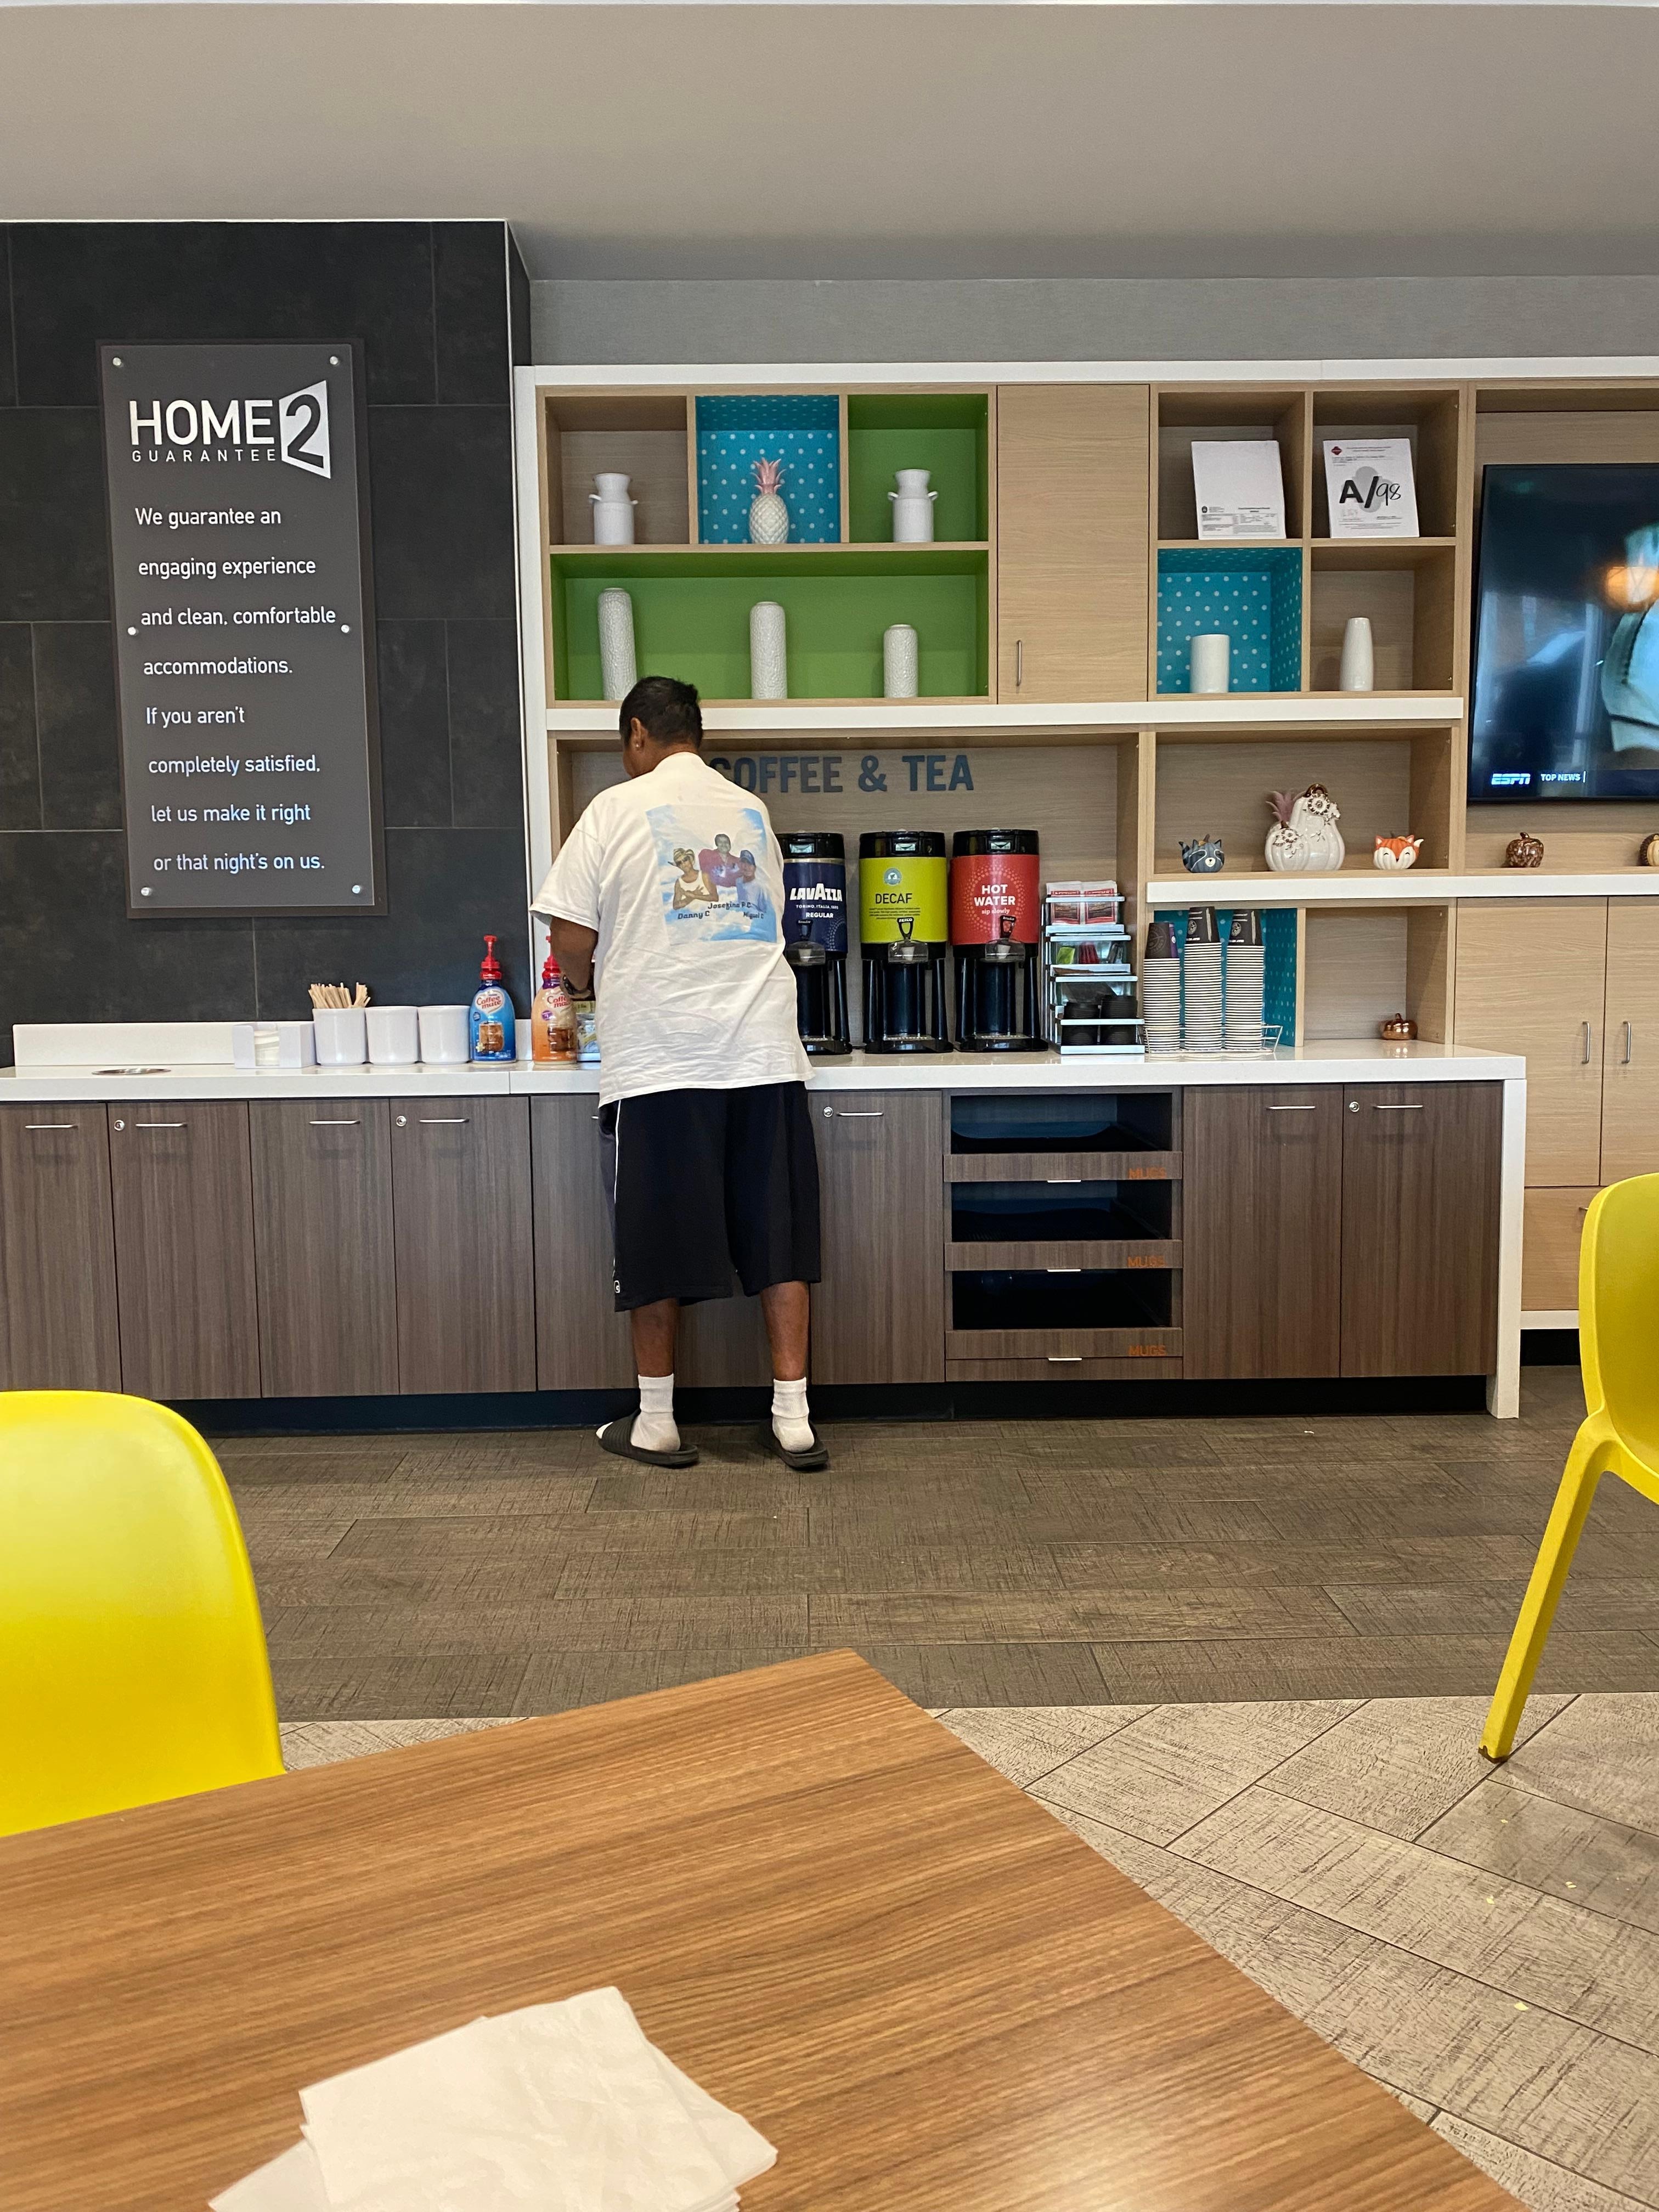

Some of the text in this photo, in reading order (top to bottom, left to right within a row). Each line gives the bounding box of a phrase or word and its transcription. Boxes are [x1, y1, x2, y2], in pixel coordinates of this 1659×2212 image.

[132, 449, 276, 462] GUARANTEE
[135, 508, 281, 529] We guarantee an
[138, 556, 317, 580] engaging experience
[140, 608, 173, 625] and
[233, 606, 337, 624] comfortable
[143, 657, 293, 675] accommodations.
[145, 706, 245, 729] If you aren't
[148, 756, 240, 777] completely
[858, 755, 888, 792] &
[902, 755, 974, 791] TEA
[1491, 773, 1531, 785] ESPN
[151, 804, 312, 825] let us make it right
[153, 853, 326, 874] or that night's on us.
[789, 883, 843, 902] LAVAZZA
[981, 884, 1008, 895] HOT
[875, 893, 913, 904] DECAF
[974, 896, 1016, 906] WATER
[476, 996, 500, 1006] Coffee
[482, 1000, 502, 1009] mate
[1128, 1167, 1167, 1180] MUGS
[1127, 1255, 1166, 1268] MUGS
[1128, 1345, 1167, 1357] MUGS
